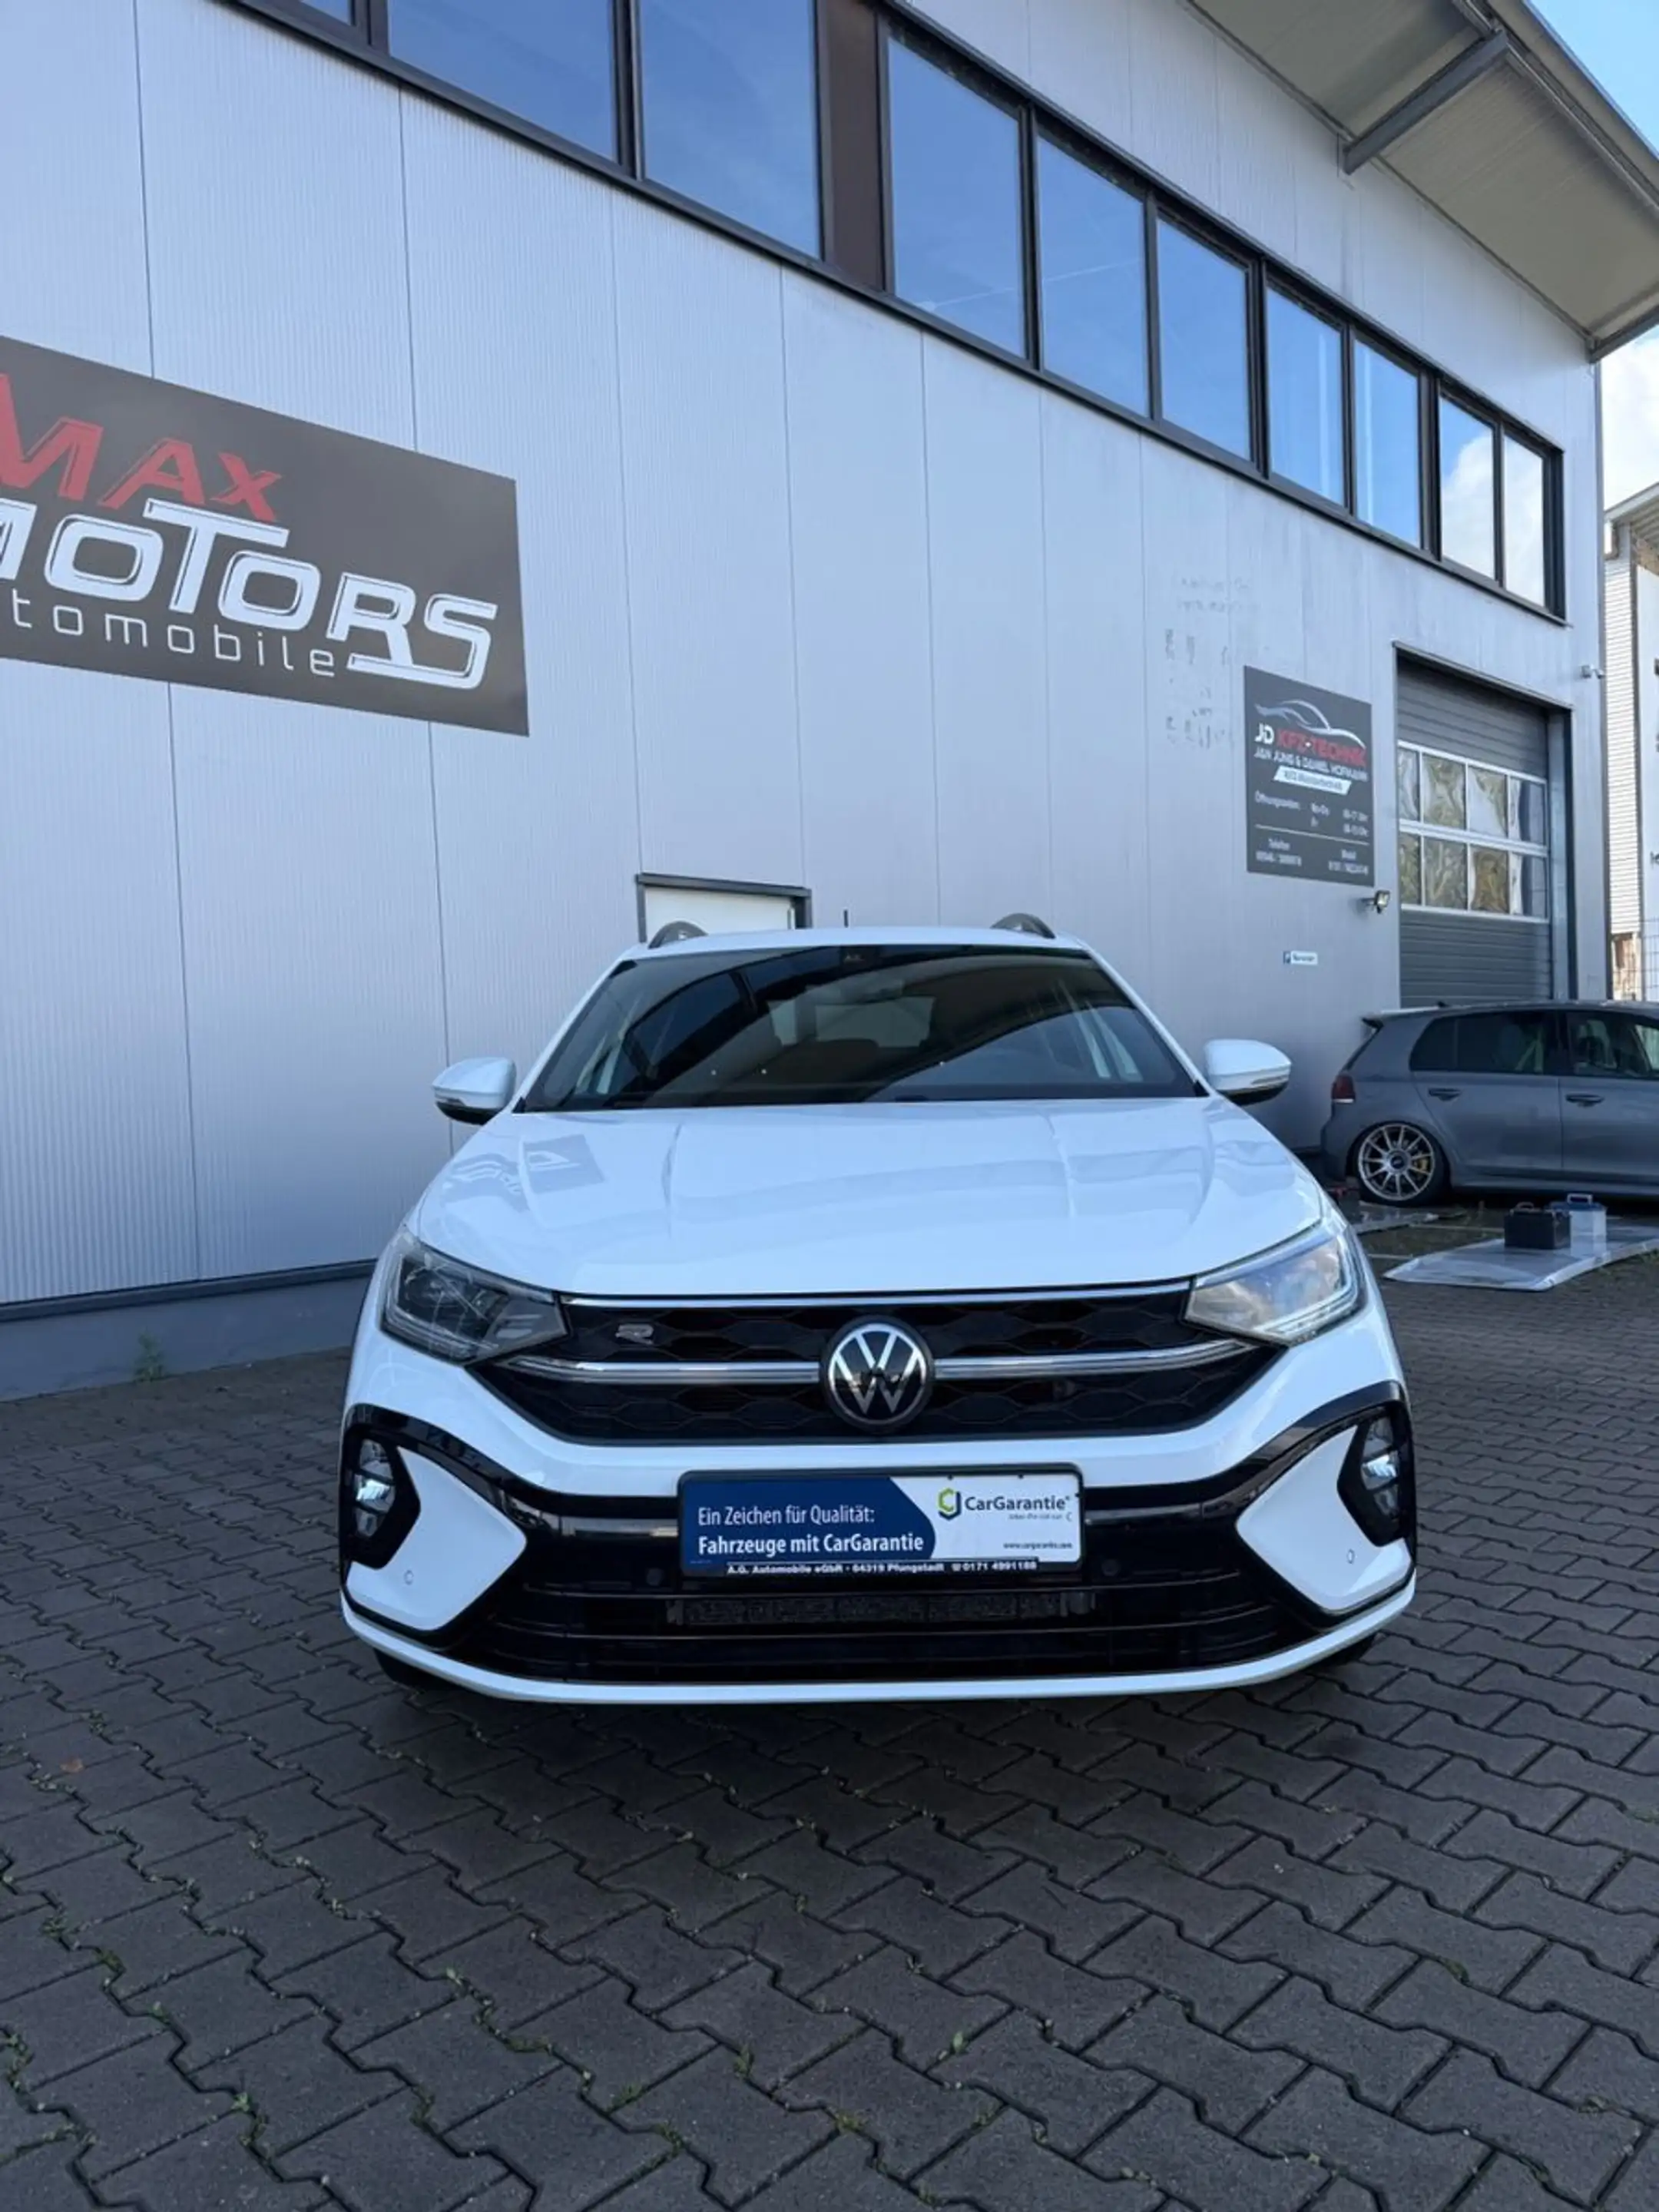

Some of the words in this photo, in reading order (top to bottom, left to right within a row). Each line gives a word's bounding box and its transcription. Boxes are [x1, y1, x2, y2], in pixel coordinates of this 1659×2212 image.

[1254, 723, 1274, 744] JD
[965, 1495, 1066, 1512] CarGarantie
[698, 1507, 720, 1525] Ein
[724, 1505, 782, 1525] Zeichen
[786, 1505, 806, 1524] für
[810, 1505, 875, 1525] Qualität:
[698, 1536, 786, 1558] Fahrzeuge
[790, 1535, 820, 1552] mit
[823, 1533, 924, 1552] CarGarantie
